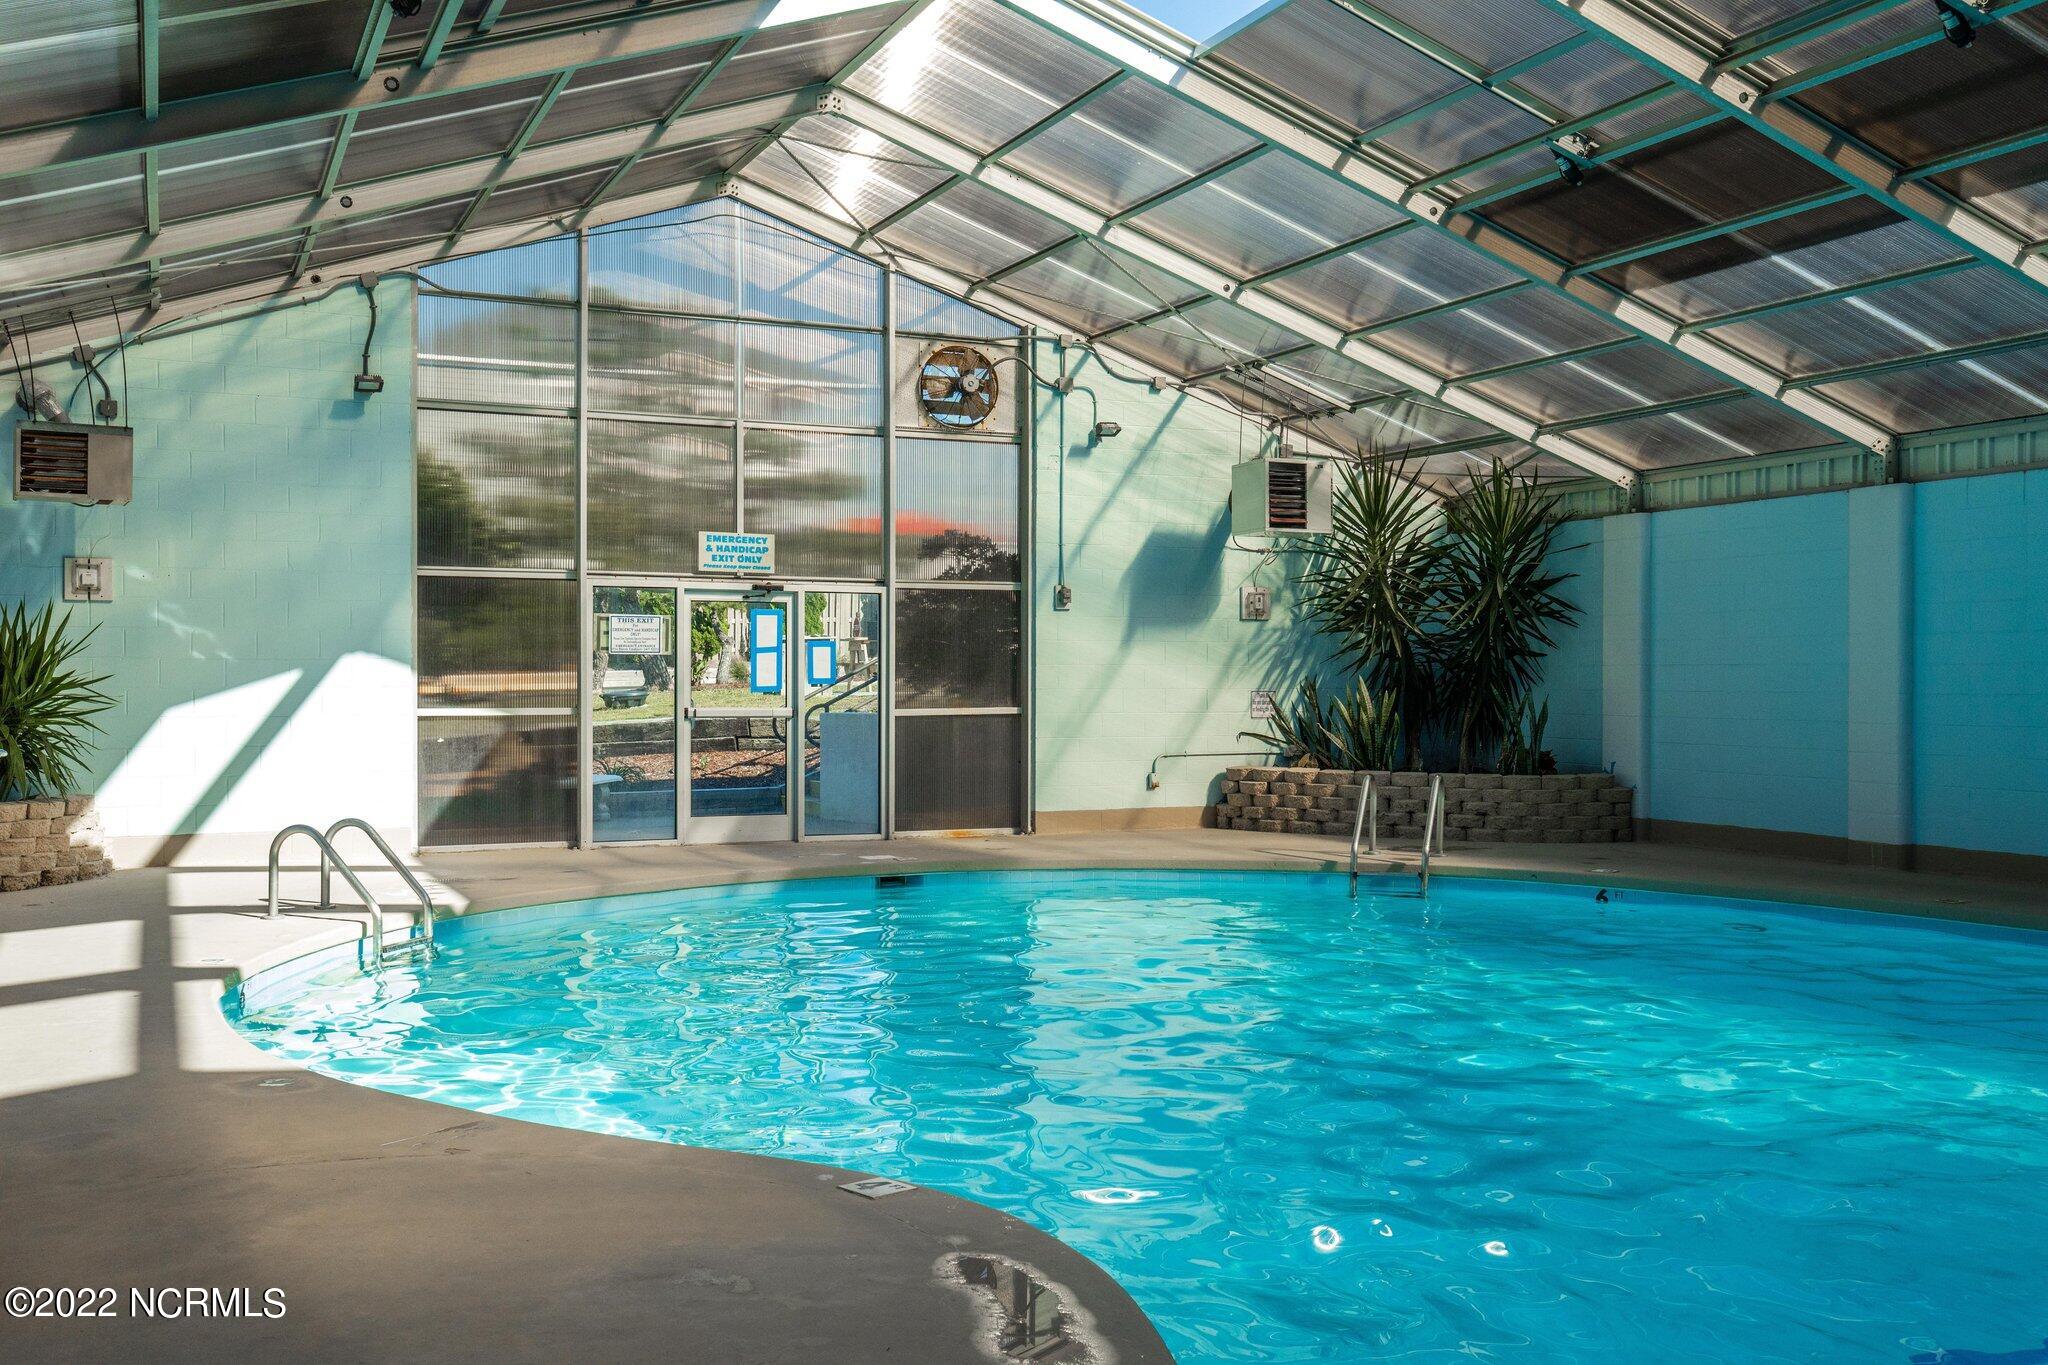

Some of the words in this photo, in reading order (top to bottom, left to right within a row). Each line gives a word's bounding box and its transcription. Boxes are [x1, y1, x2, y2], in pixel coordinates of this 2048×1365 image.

[706, 534, 768, 544] EMERGENCY
[705, 544, 713, 552] &
[716, 545, 769, 554] HANDICAP
[711, 554, 735, 562] EXIT
[737, 555, 762, 563] ONLY
[1595, 888, 1609, 904] 6
